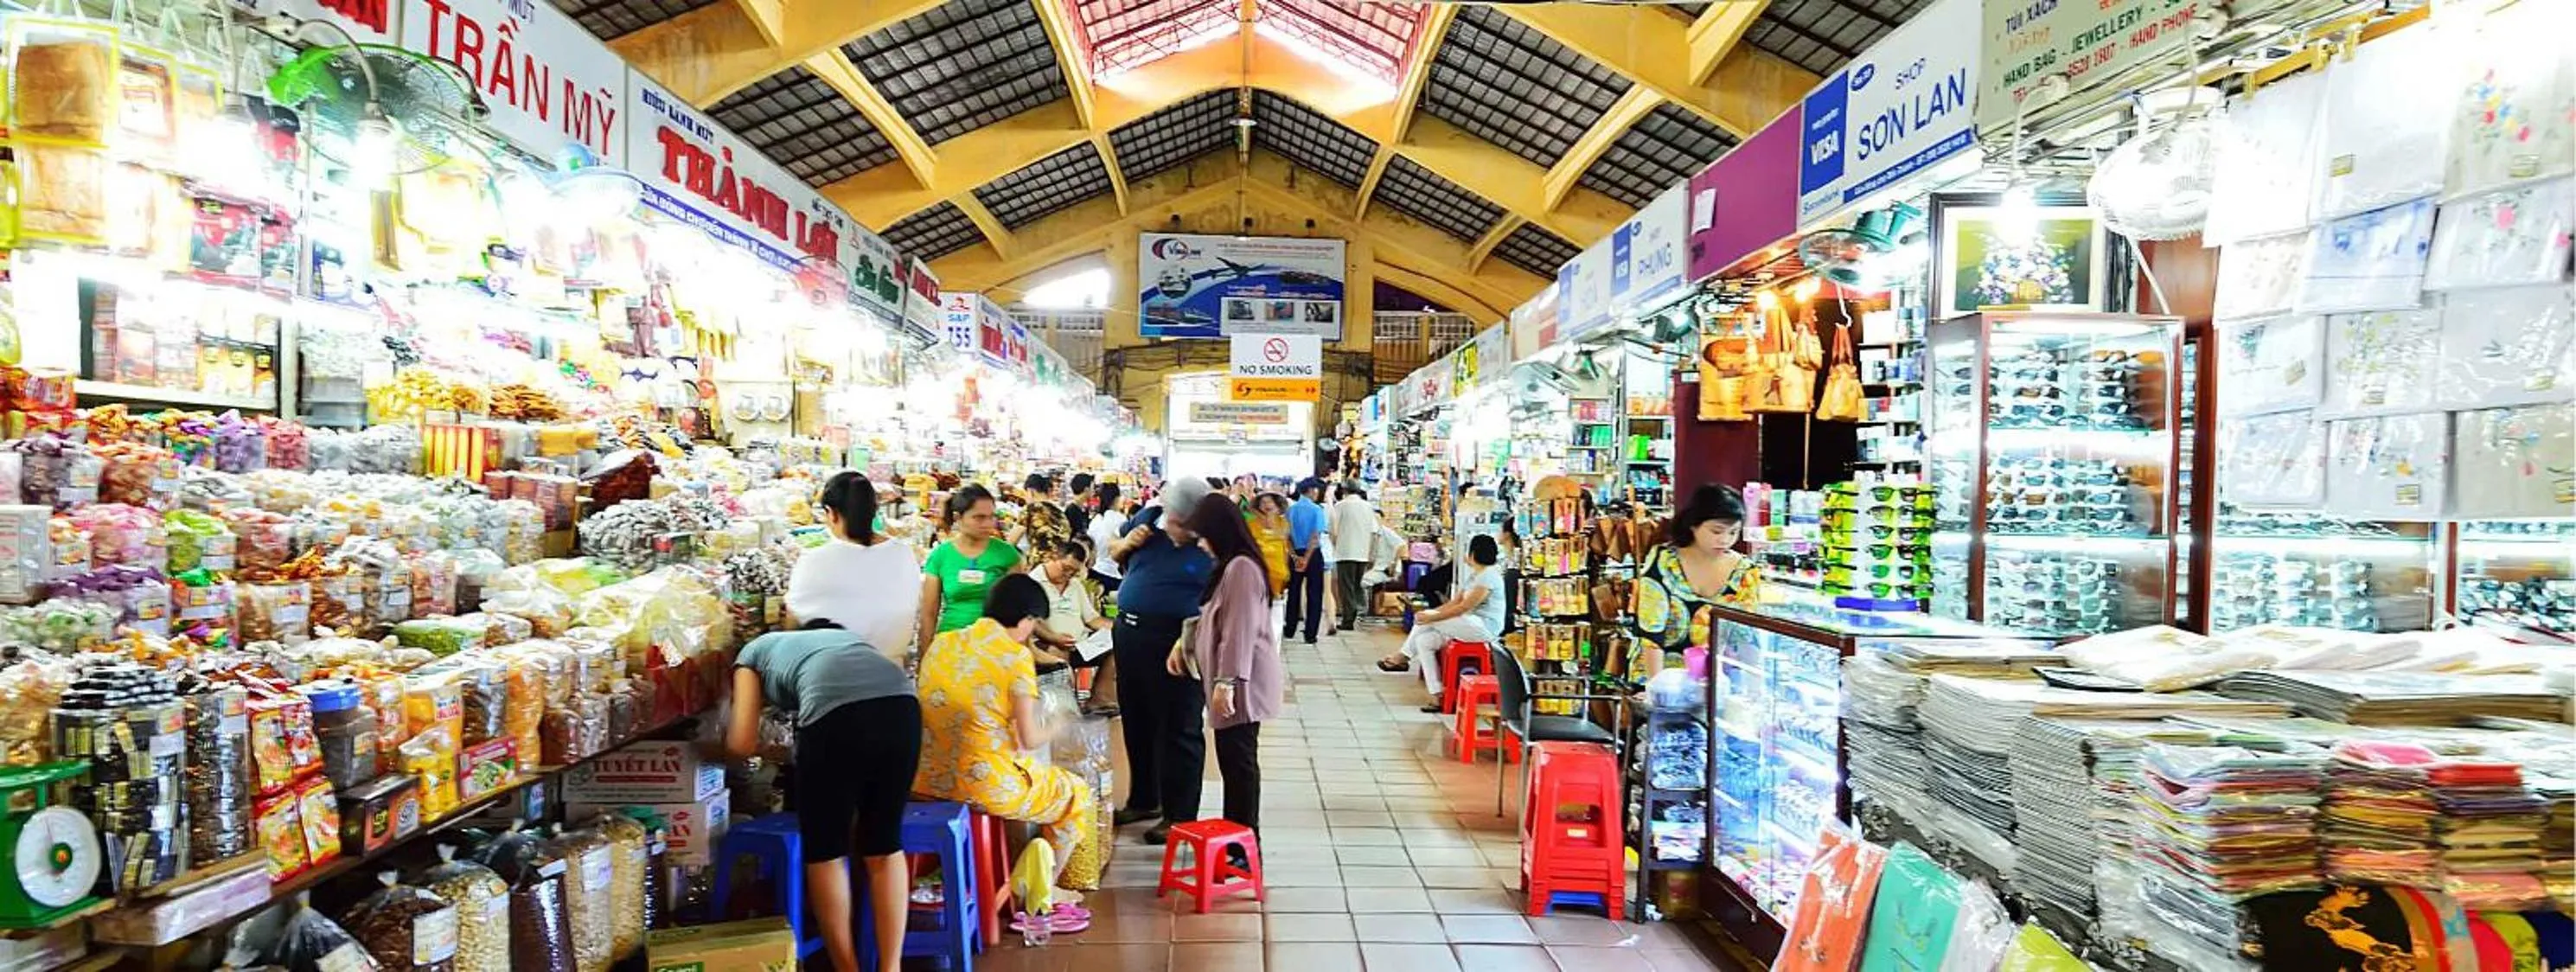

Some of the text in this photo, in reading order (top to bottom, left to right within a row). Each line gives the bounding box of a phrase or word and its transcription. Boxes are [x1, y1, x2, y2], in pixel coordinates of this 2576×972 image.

[2033, 48, 2056, 72] BAG
[2072, 4, 2143, 54] JEWELLERY
[422, 0, 617, 157] TRẦN MỸ
[1895, 57, 1927, 90] SHOP
[1914, 67, 1966, 131] LAN
[1810, 130, 1840, 165] VISA
[1239, 365, 1314, 375] NO SMOKING
[649, 758, 681, 772] LAN
[672, 824, 691, 836] AN
